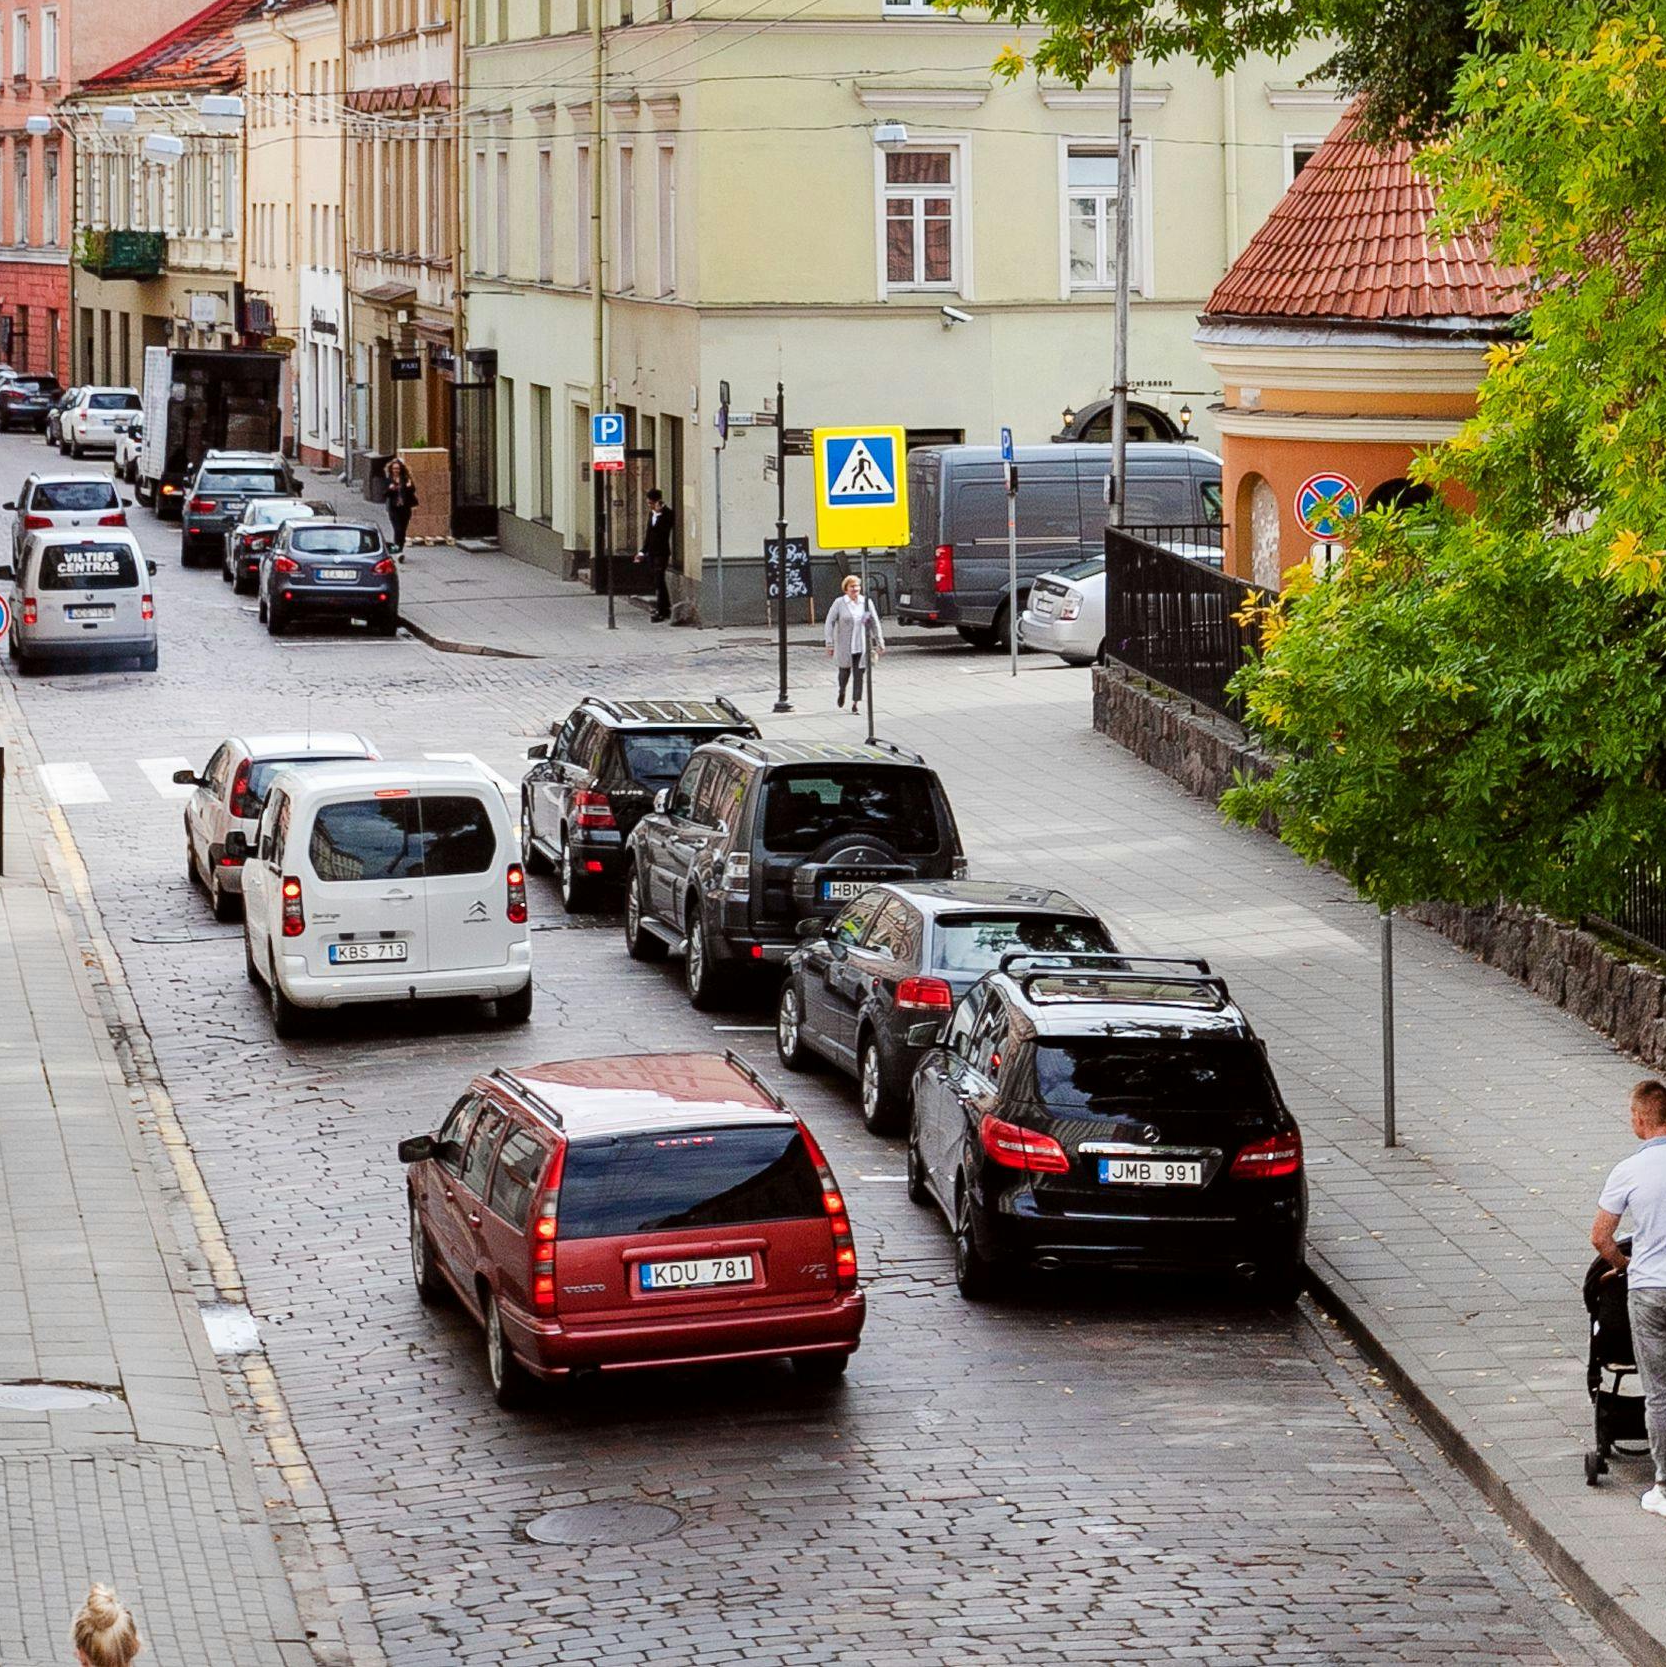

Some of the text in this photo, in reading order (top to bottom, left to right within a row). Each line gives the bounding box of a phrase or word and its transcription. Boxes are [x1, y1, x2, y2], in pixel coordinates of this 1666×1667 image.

[600, 417, 619, 442] P
[63, 551, 115, 563] VILTIES
[57, 561, 120, 573] CENTRAS
[832, 883, 863, 898] HBN
[338, 944, 404, 959] KBS 713
[1111, 1163, 1197, 1182] JMB 991
[654, 1259, 749, 1285] KDU 781
